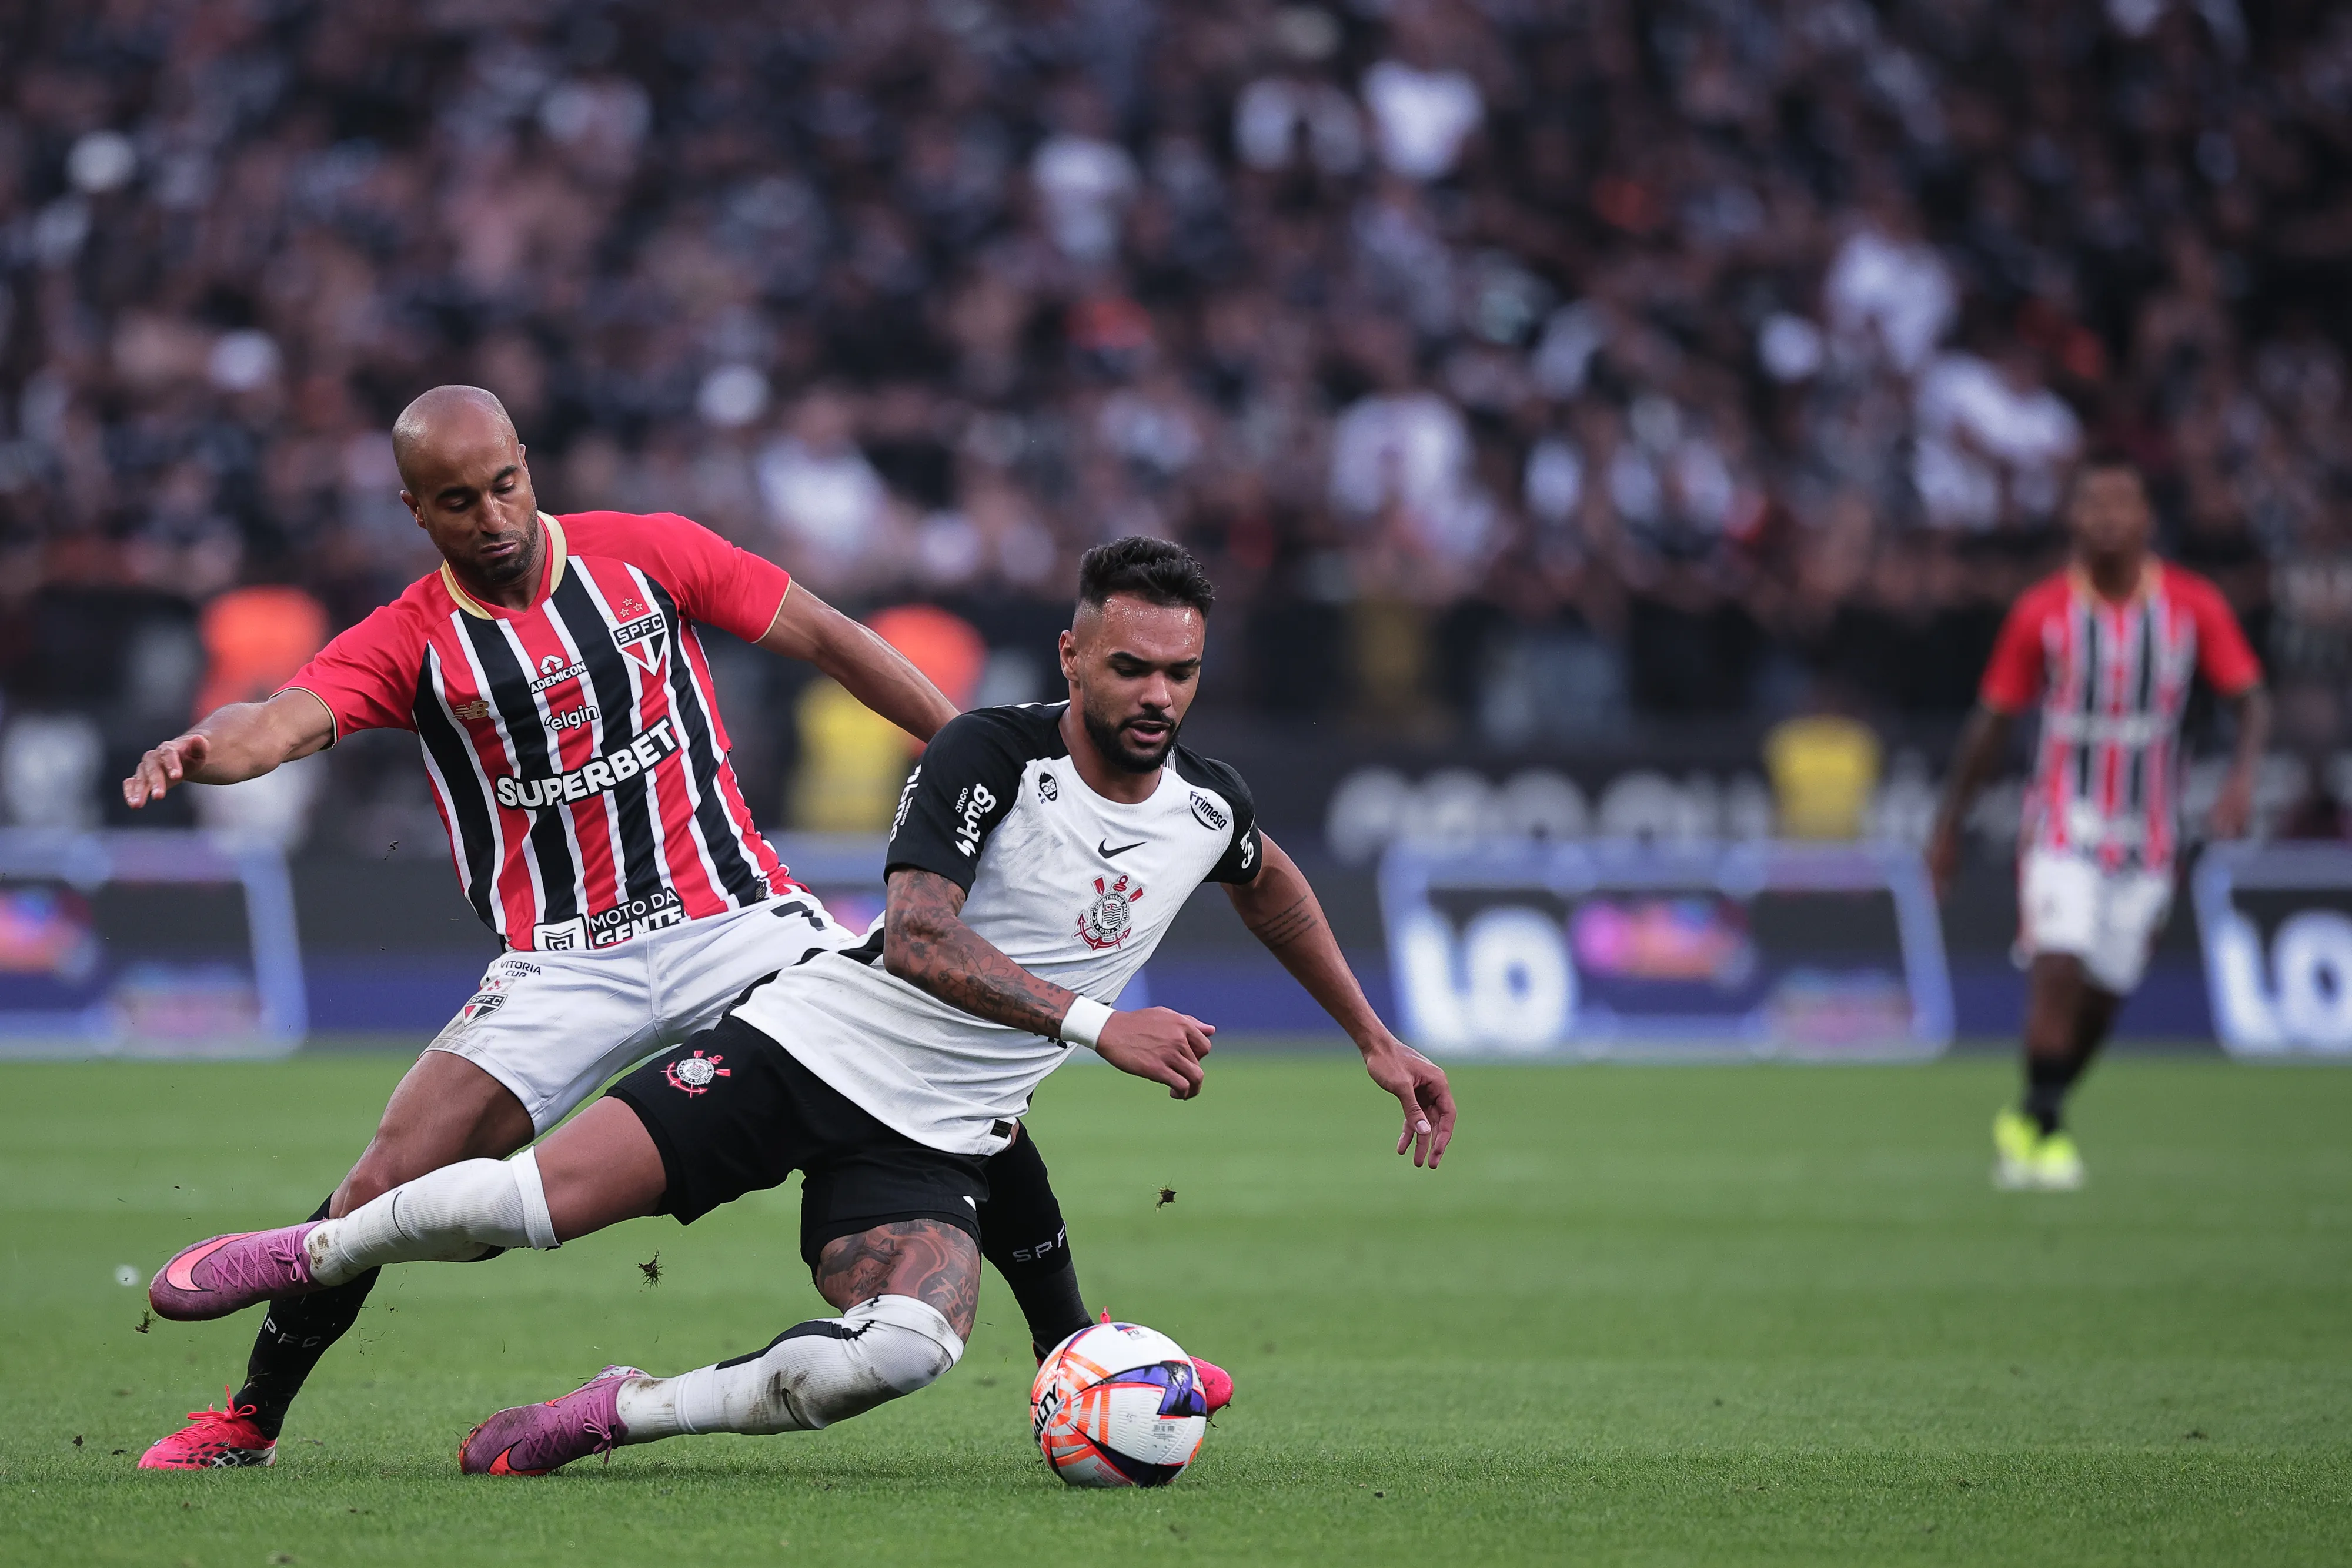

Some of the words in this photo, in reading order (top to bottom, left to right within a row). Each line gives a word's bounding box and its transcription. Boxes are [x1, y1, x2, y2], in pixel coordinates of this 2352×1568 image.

[616, 616, 663, 643] SPFC
[530, 661, 587, 694] ADEMICON
[551, 705, 599, 730] elgin
[497, 718, 676, 807] SUPERBET
[900, 797, 914, 826] banco
[955, 787, 969, 813] anco
[956, 783, 997, 843] bmg
[1189, 790, 1227, 830] Frimesa
[590, 901, 647, 932] MOTO
[650, 890, 680, 910] DA
[500, 961, 542, 975] VITORIA
[470, 995, 503, 1005] SPFC
[1012, 1221, 1066, 1262] SPF
[259, 1308, 321, 1348] PFC
